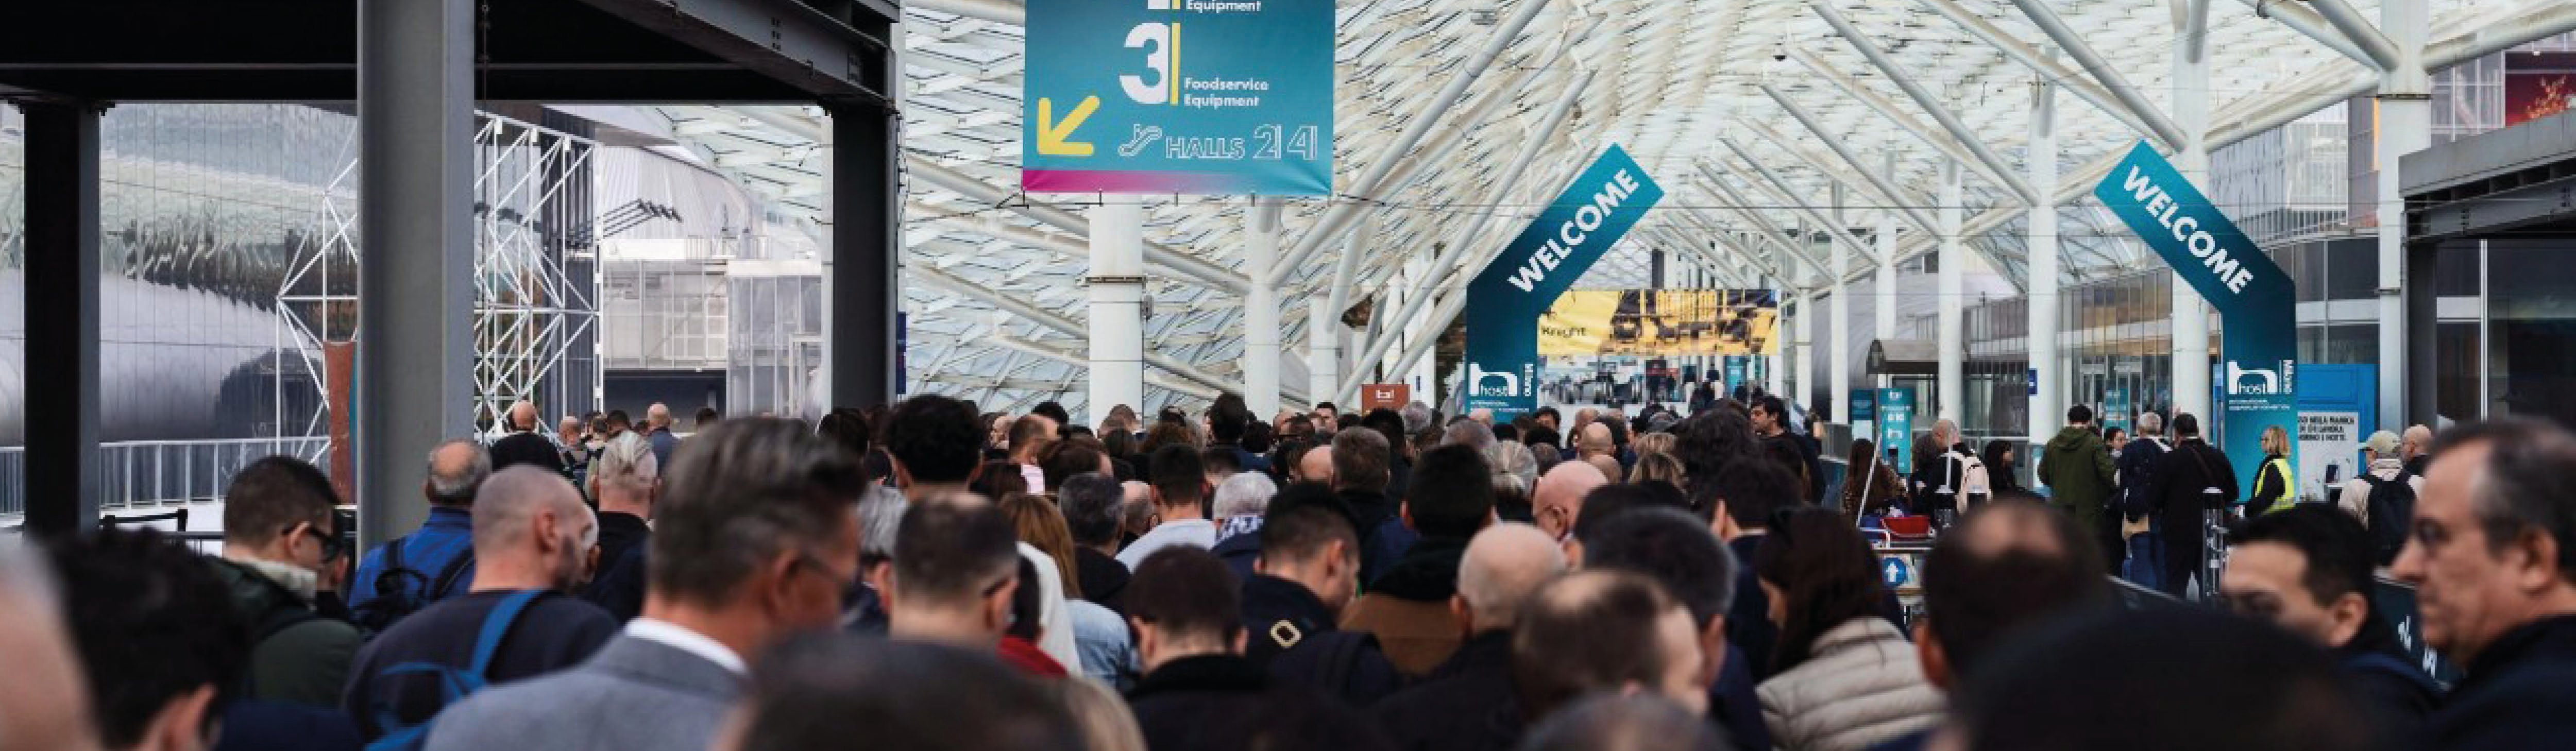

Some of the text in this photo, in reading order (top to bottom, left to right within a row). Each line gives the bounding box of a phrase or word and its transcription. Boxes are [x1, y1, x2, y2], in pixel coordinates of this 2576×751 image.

[1186, 0, 1261, 13] Equipment
[1120, 23, 1171, 104] 3
[1184, 77, 1269, 91] Foodservice
[1184, 93, 1260, 110] Equipment
[1165, 136, 1245, 159] HALLS
[1507, 168, 1640, 292] WELCOME
[2124, 164, 2253, 294] WELCOME
[1480, 384, 1508, 397] host
[2239, 382, 2266, 395] host
